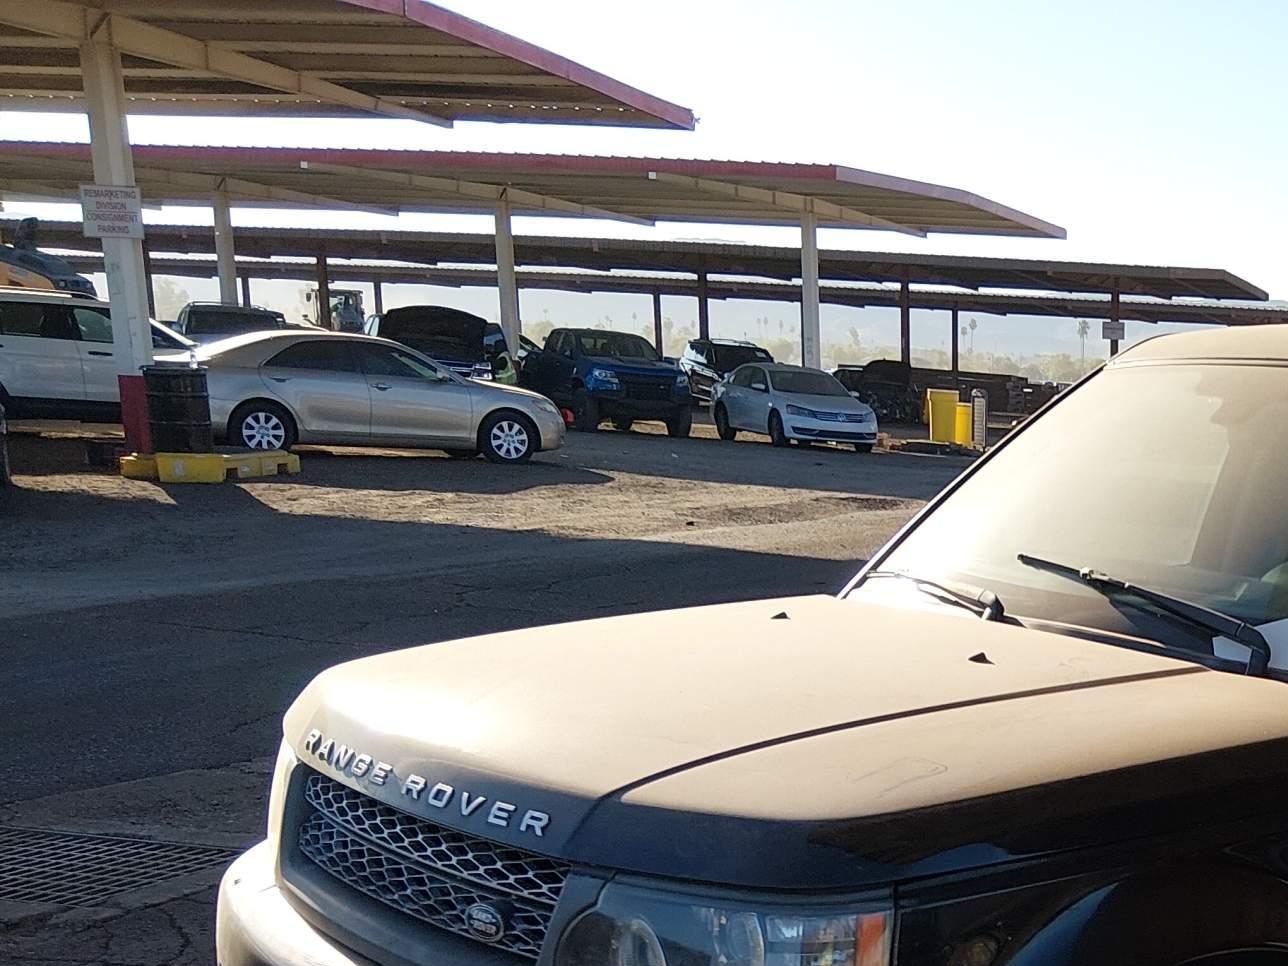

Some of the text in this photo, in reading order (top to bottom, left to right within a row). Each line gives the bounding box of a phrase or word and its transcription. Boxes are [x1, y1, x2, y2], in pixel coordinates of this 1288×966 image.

[83, 188, 137, 200] REMARKETING
[95, 200, 128, 211] DIVISION
[86, 212, 139, 224] CONSIGNMENT
[97, 224, 130, 234] PARKING
[304, 728, 551, 837] RANGE ROVER
